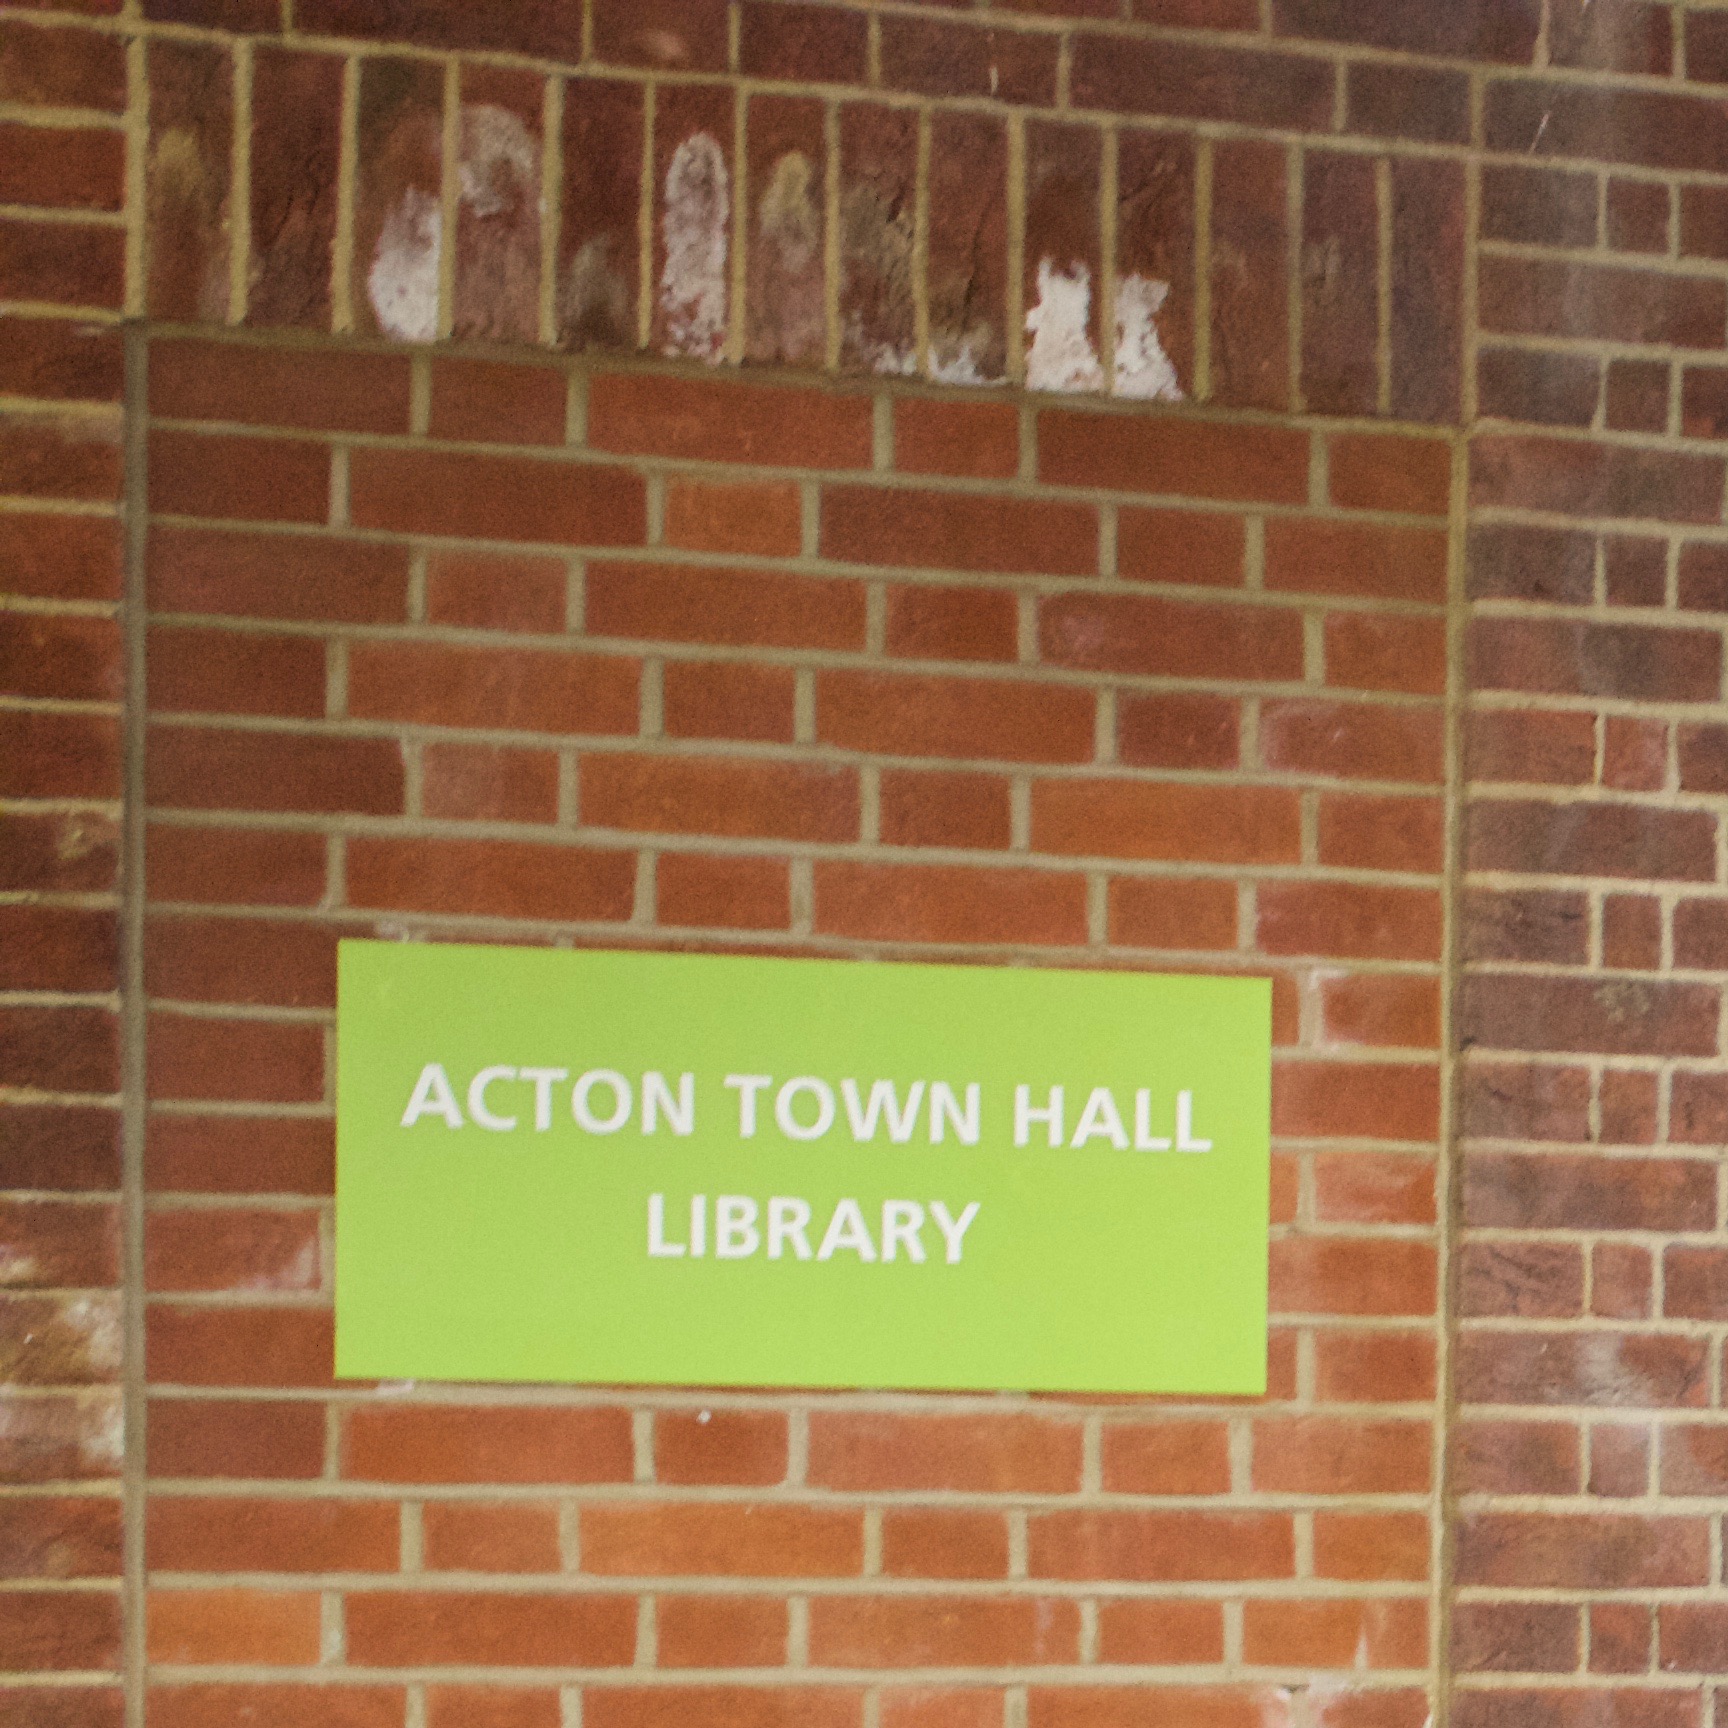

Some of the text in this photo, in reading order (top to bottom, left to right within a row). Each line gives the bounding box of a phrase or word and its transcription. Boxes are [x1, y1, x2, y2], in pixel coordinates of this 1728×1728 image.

[400, 1063, 1214, 1154] ACTON TOWN HALL
[647, 1192, 982, 1265] LIBRARY
